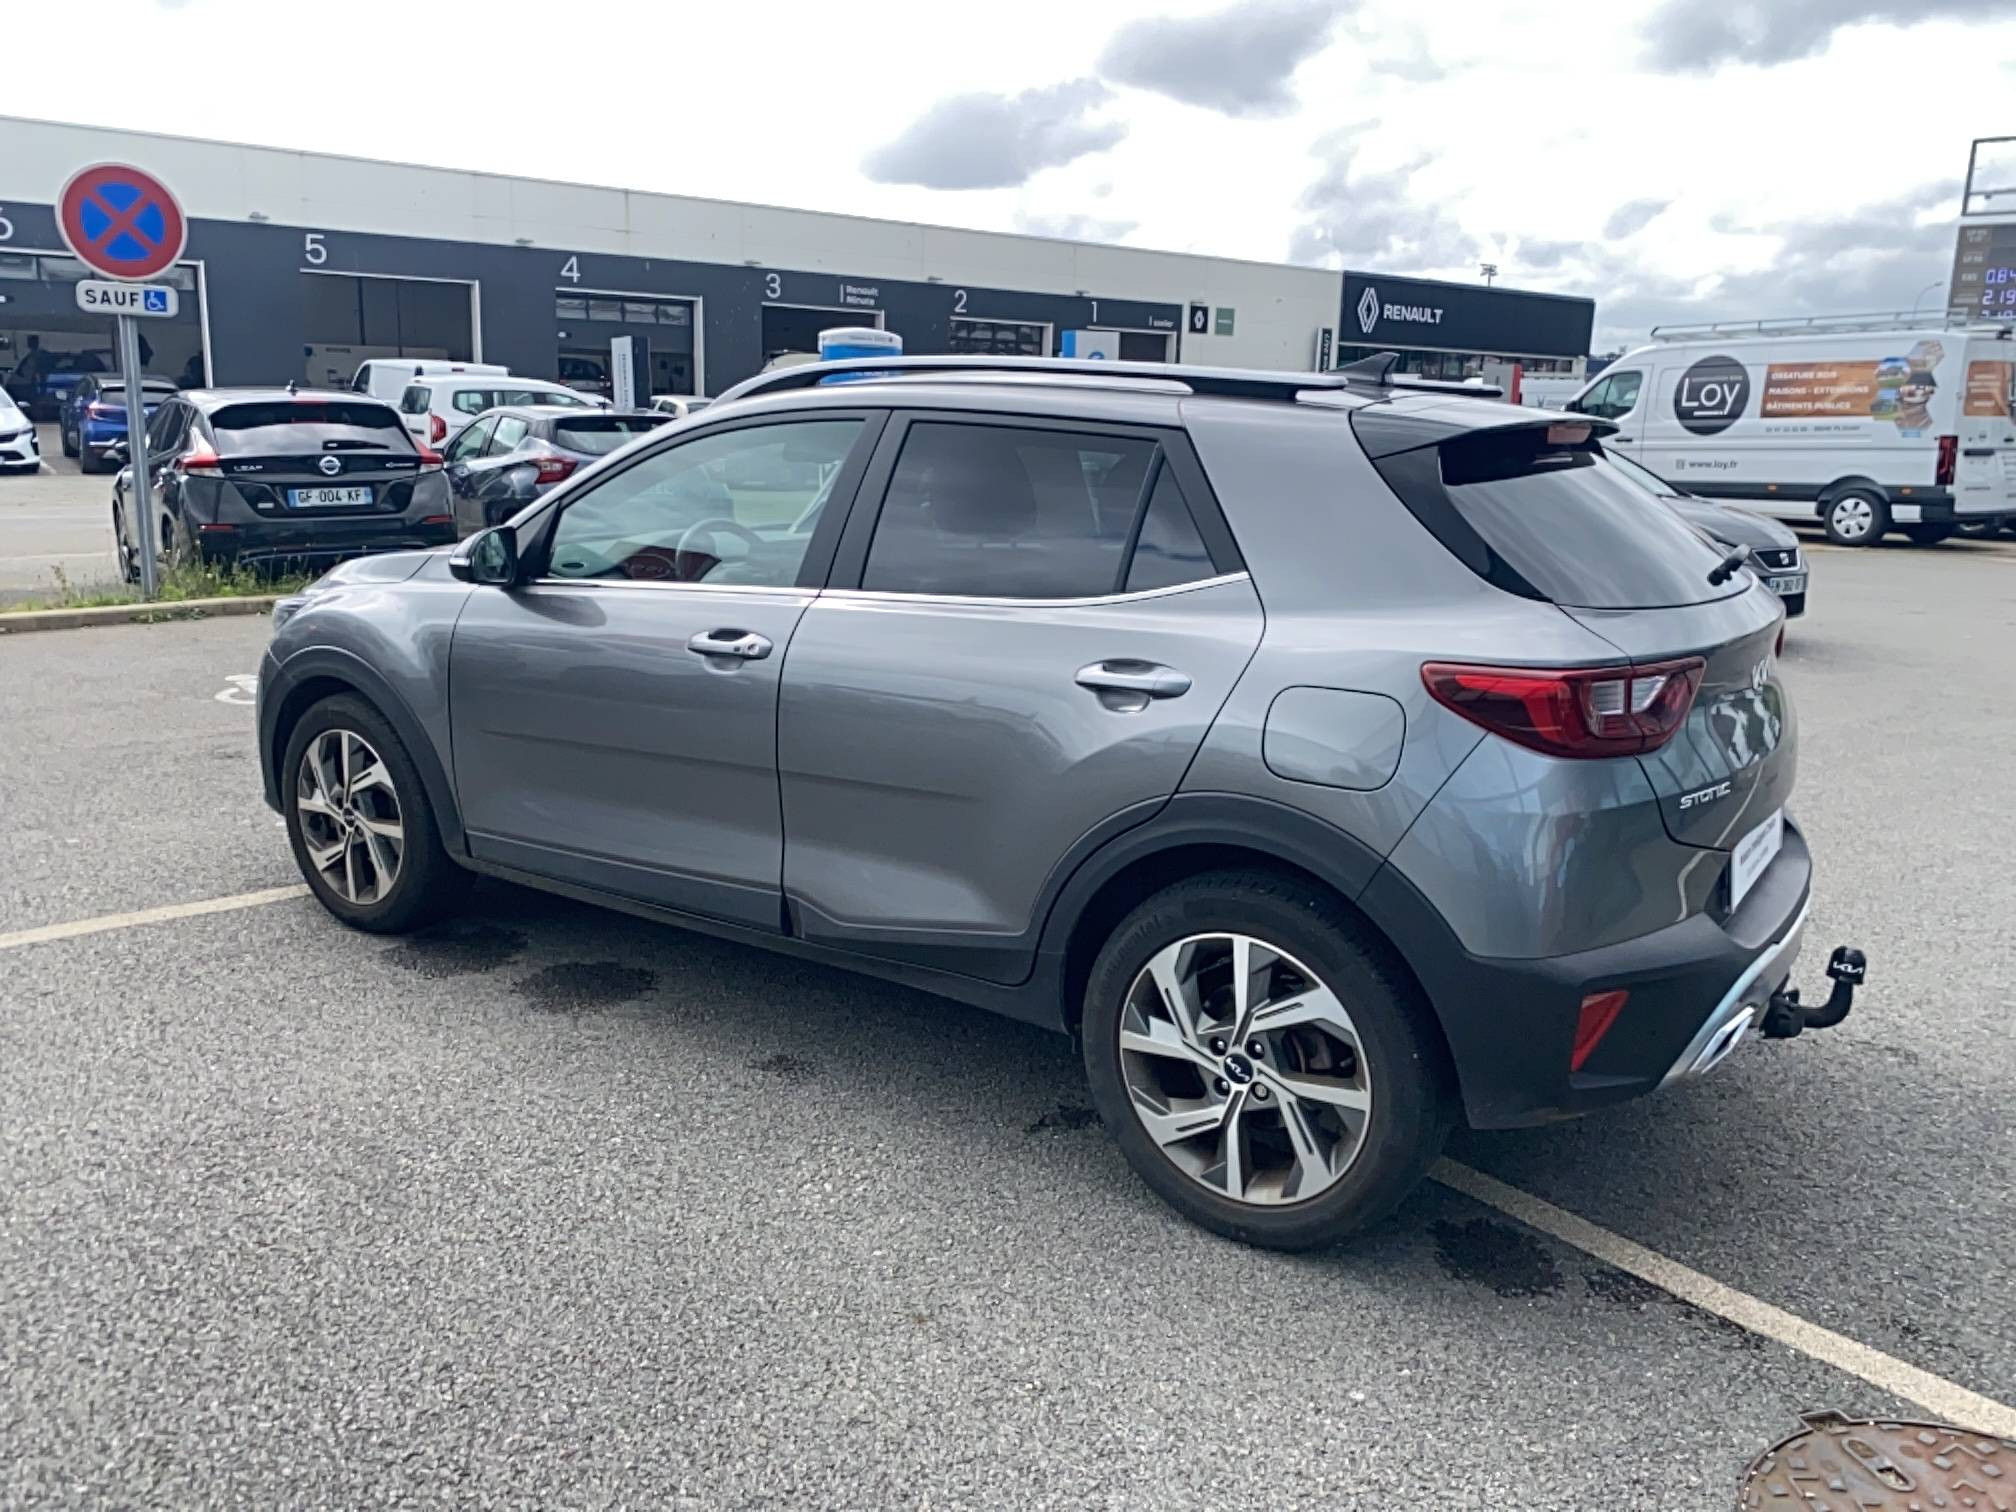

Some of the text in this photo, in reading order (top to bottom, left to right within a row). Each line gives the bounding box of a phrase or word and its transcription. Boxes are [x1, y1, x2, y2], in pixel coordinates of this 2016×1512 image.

[304, 233, 327, 265] 5
[560, 255, 582, 284] 4
[765, 273, 782, 299] 3
[846, 285, 879, 297] Renault
[84, 289, 140, 307] SAUF
[953, 289, 968, 314] 2
[1091, 301, 1098, 323] 1
[1383, 303, 1444, 324] RENAULT
[1771, 370, 1838, 380] OSSATURE BOIS
[1681, 377, 1741, 416] Loy
[1768, 387, 1807, 395] MAISONS
[1813, 385, 1870, 394] EXTENSIONS
[1814, 401, 1852, 410] PUBLICS
[1688, 460, 1739, 471] www.loy.fr
[1679, 781, 1731, 810] STONIC
